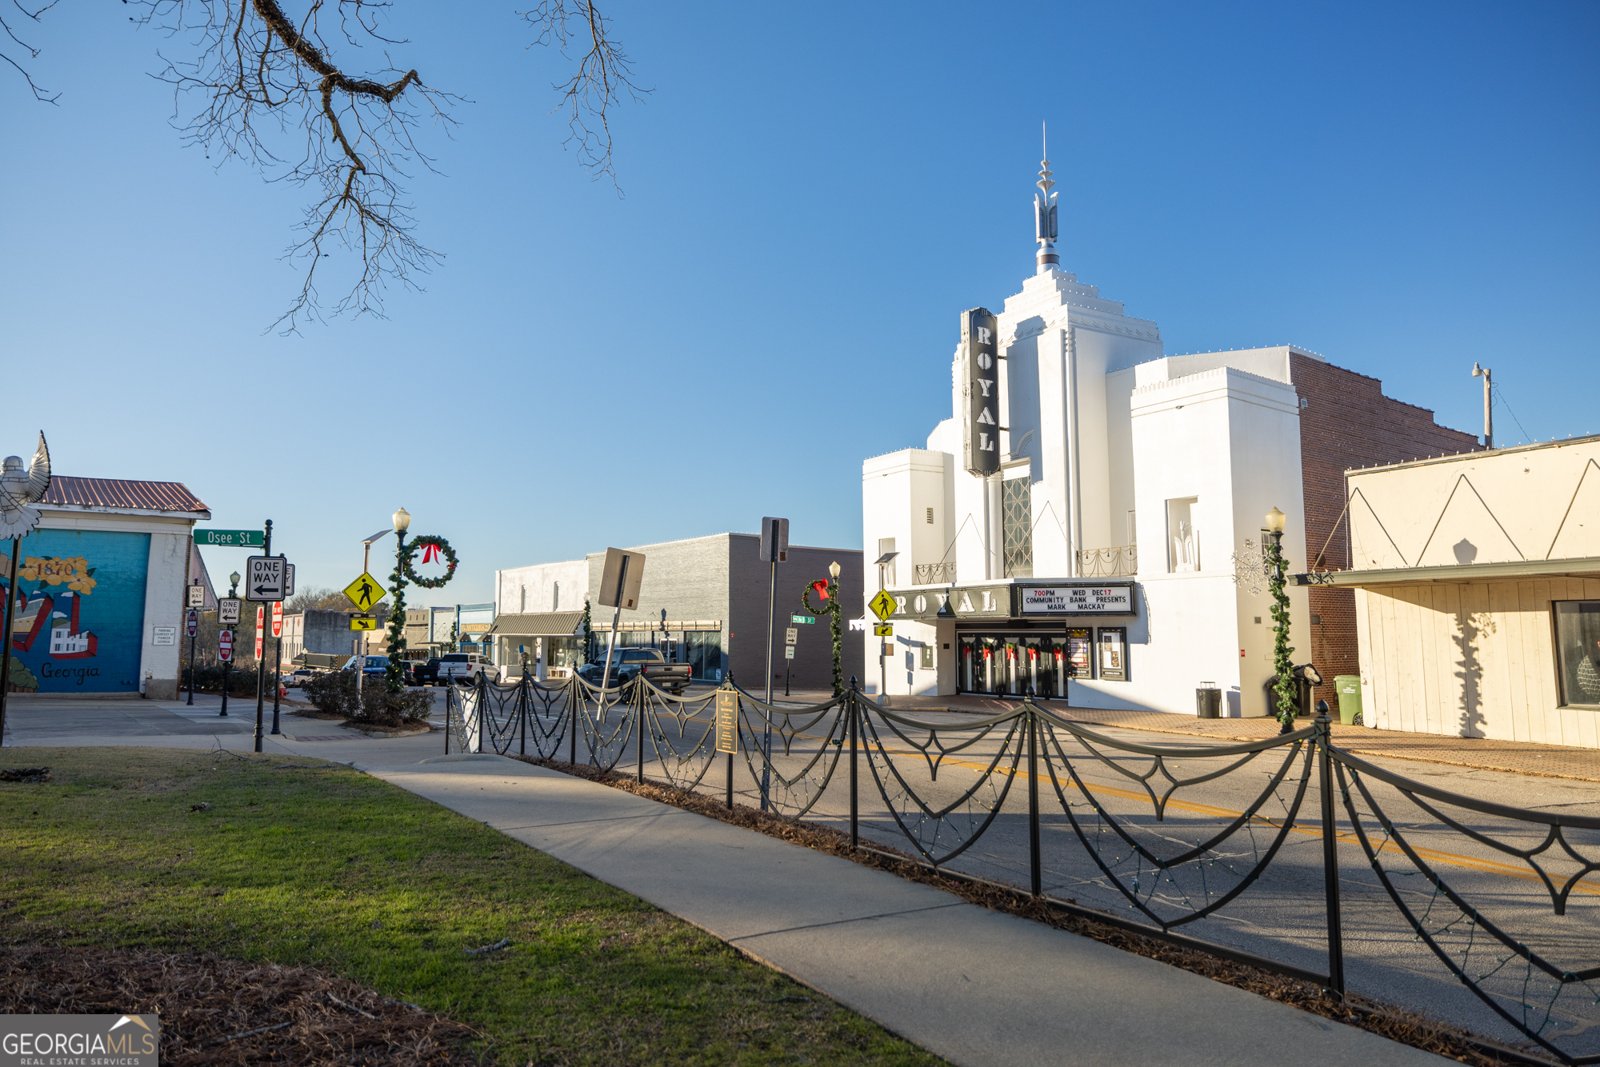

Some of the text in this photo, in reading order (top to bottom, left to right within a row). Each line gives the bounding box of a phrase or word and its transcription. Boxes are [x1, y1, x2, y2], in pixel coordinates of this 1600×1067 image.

[976, 326, 996, 452] ROYAL
[208, 531, 250, 544] Osee St
[37, 562, 74, 576] 1870
[254, 562, 280, 572] ONE
[254, 573, 280, 583] WAY
[894, 591, 996, 614] ROYAL
[41, 662, 100, 686] Georgia
